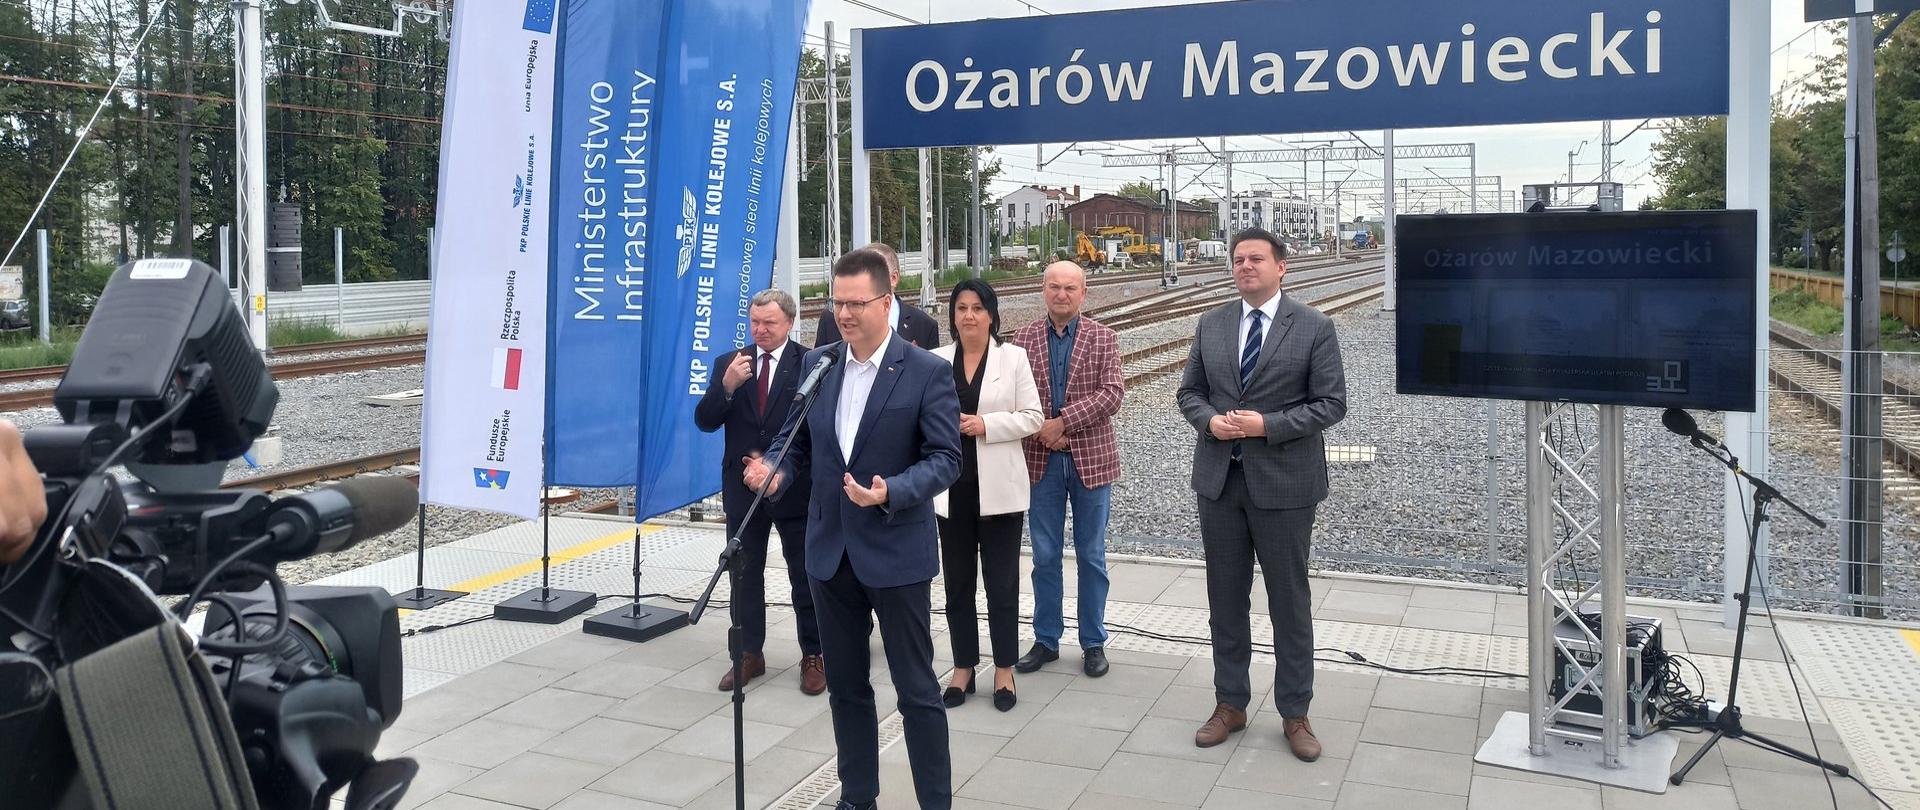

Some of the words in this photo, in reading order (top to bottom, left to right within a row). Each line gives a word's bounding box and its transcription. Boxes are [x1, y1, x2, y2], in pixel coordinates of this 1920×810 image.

[525, 39, 539, 90] Europejska
[905, 48, 1153, 112] Ożarów
[1182, 10, 1662, 98] Mazowiecki
[716, 73, 737, 112] S.A.
[751, 78, 774, 165] kolejowych
[526, 149, 535, 187] KOLEJOWE
[704, 118, 731, 216] KOLEJOWE
[748, 167, 763, 195] linii
[525, 188, 533, 206] LINIE
[574, 81, 614, 320] Ministerstwo
[615, 69, 656, 321] Infrastruktury
[743, 197, 759, 234] sieci
[521, 207, 531, 237] POLSKIE
[684, 219, 694, 246] PLK
[519, 238, 528, 253] PKP
[699, 222, 720, 269] LINIE
[1423, 247, 1518, 269] Ożarów
[1527, 239, 1713, 267] Mazowiecki
[737, 238, 757, 318] narodowej
[500, 270, 516, 340] Rzeczpospolita
[510, 310, 521, 341] Polska
[692, 275, 714, 352] POLSKIE
[688, 358, 709, 395] PKP
[486, 418, 500, 461] Fundusze
[495, 409, 511, 462] Europejskie
